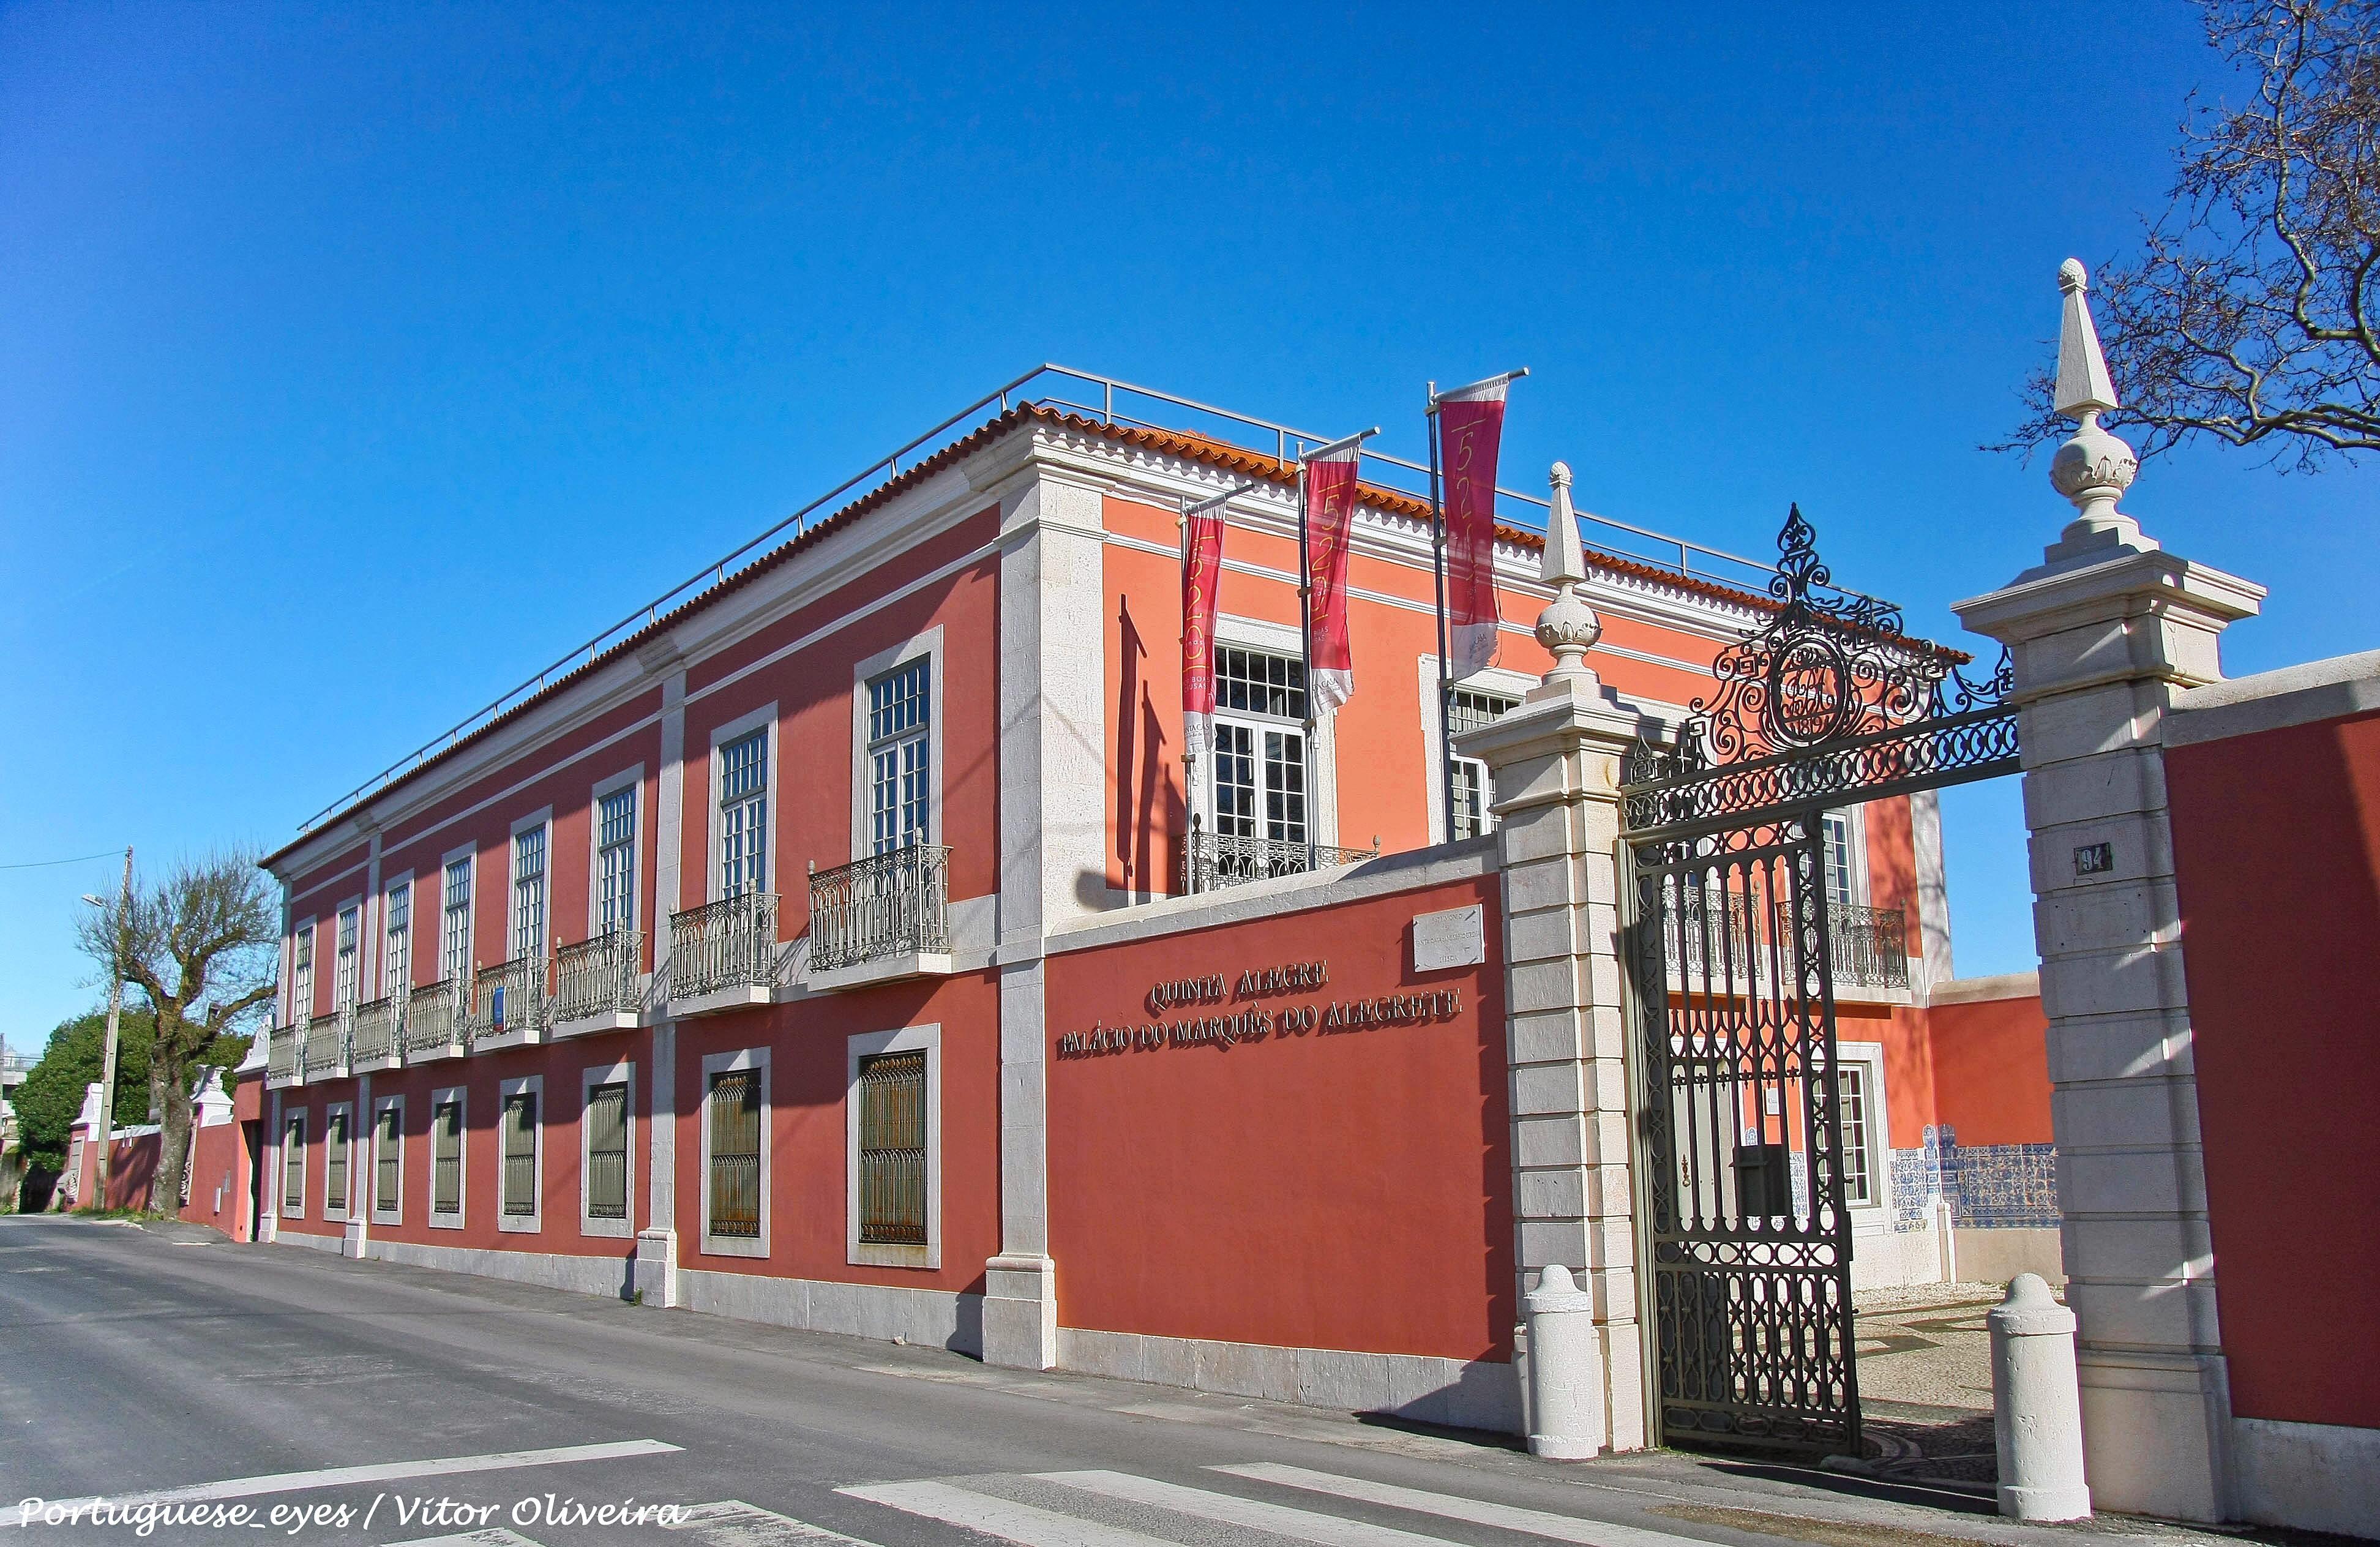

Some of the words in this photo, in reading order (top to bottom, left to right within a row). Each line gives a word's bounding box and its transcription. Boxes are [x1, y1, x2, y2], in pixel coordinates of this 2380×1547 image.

[2081, 847, 2104, 871] 94
[1152, 973, 1227, 1009] QUINTA
[1238, 960, 1330, 994] ALEGRE
[1063, 1020, 1134, 1052] PALÁCIO
[1140, 1022, 1169, 1045] DO
[1176, 1002, 1274, 1044] MARQUÊS
[1285, 1005, 1317, 1030] DO
[1328, 988, 1464, 1028] ALEGRETE
